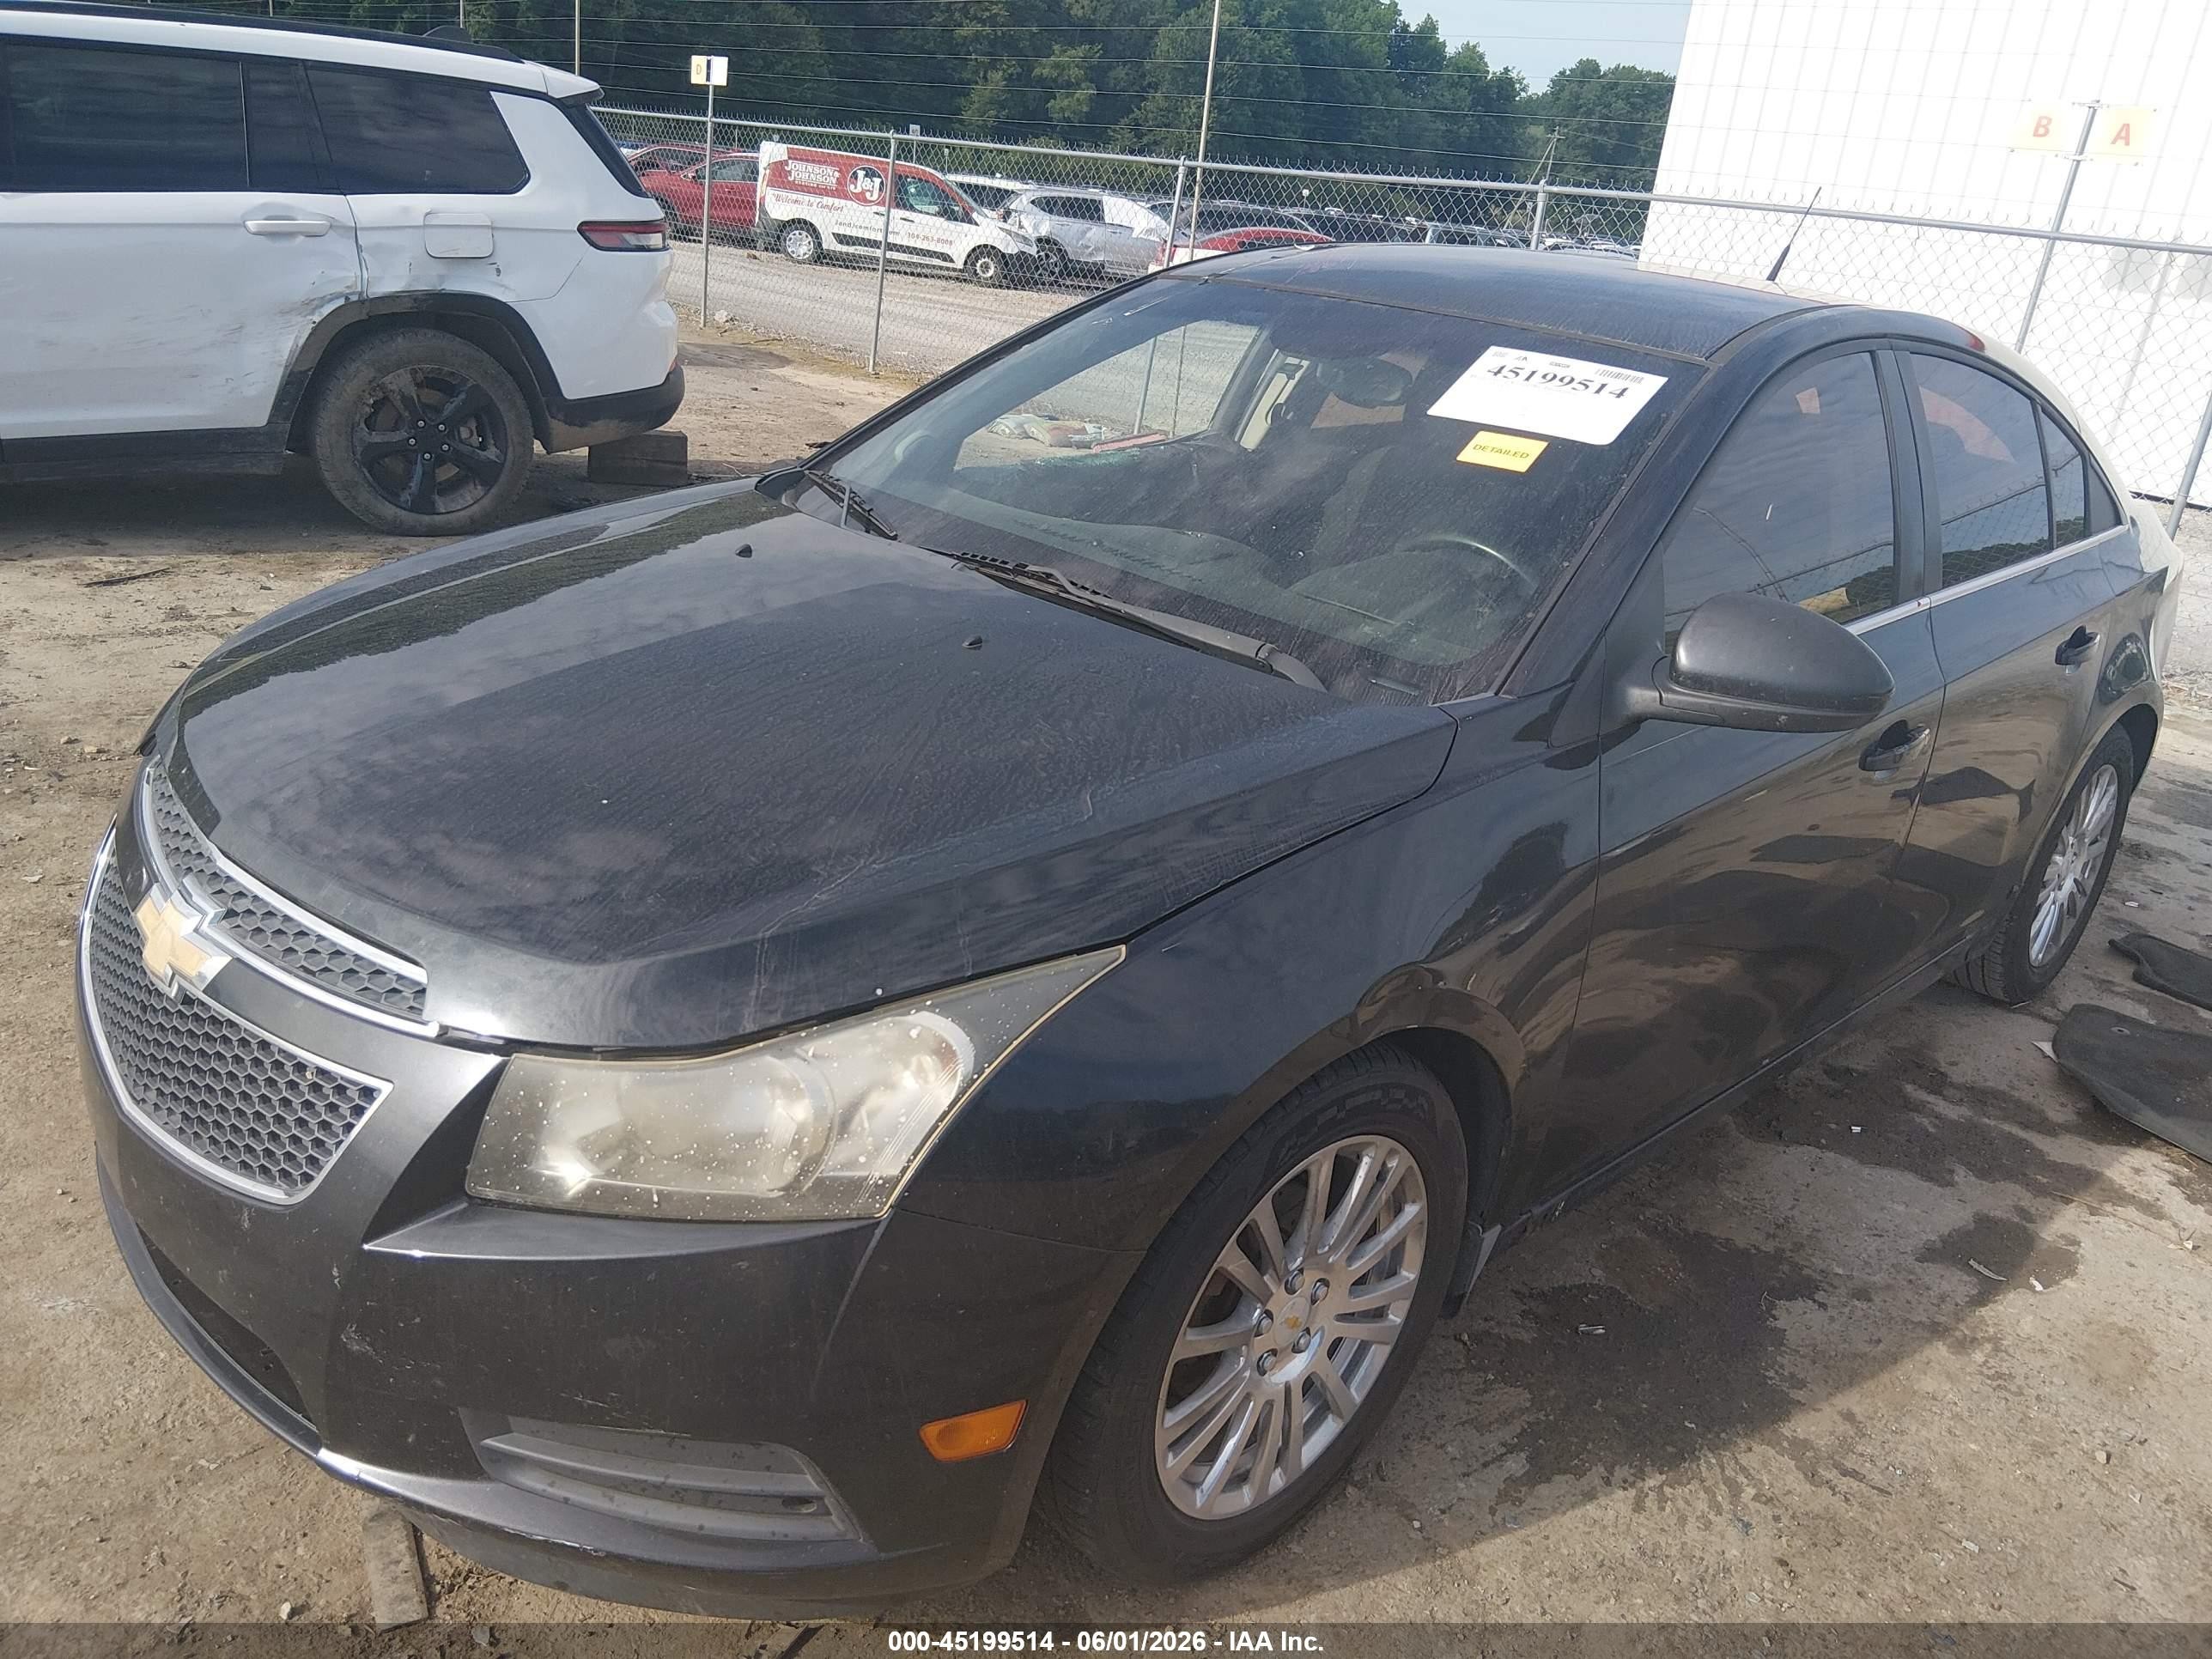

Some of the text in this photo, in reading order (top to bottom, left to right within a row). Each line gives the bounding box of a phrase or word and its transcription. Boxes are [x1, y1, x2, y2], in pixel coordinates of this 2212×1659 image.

[2033, 115, 2052, 137] B
[2110, 123, 2130, 146] A
[788, 169, 837, 185] JOHNSON
[849, 169, 882, 202] J&J
[1487, 364, 1629, 398] 45199514
[1473, 444, 1529, 459] DETAILED
